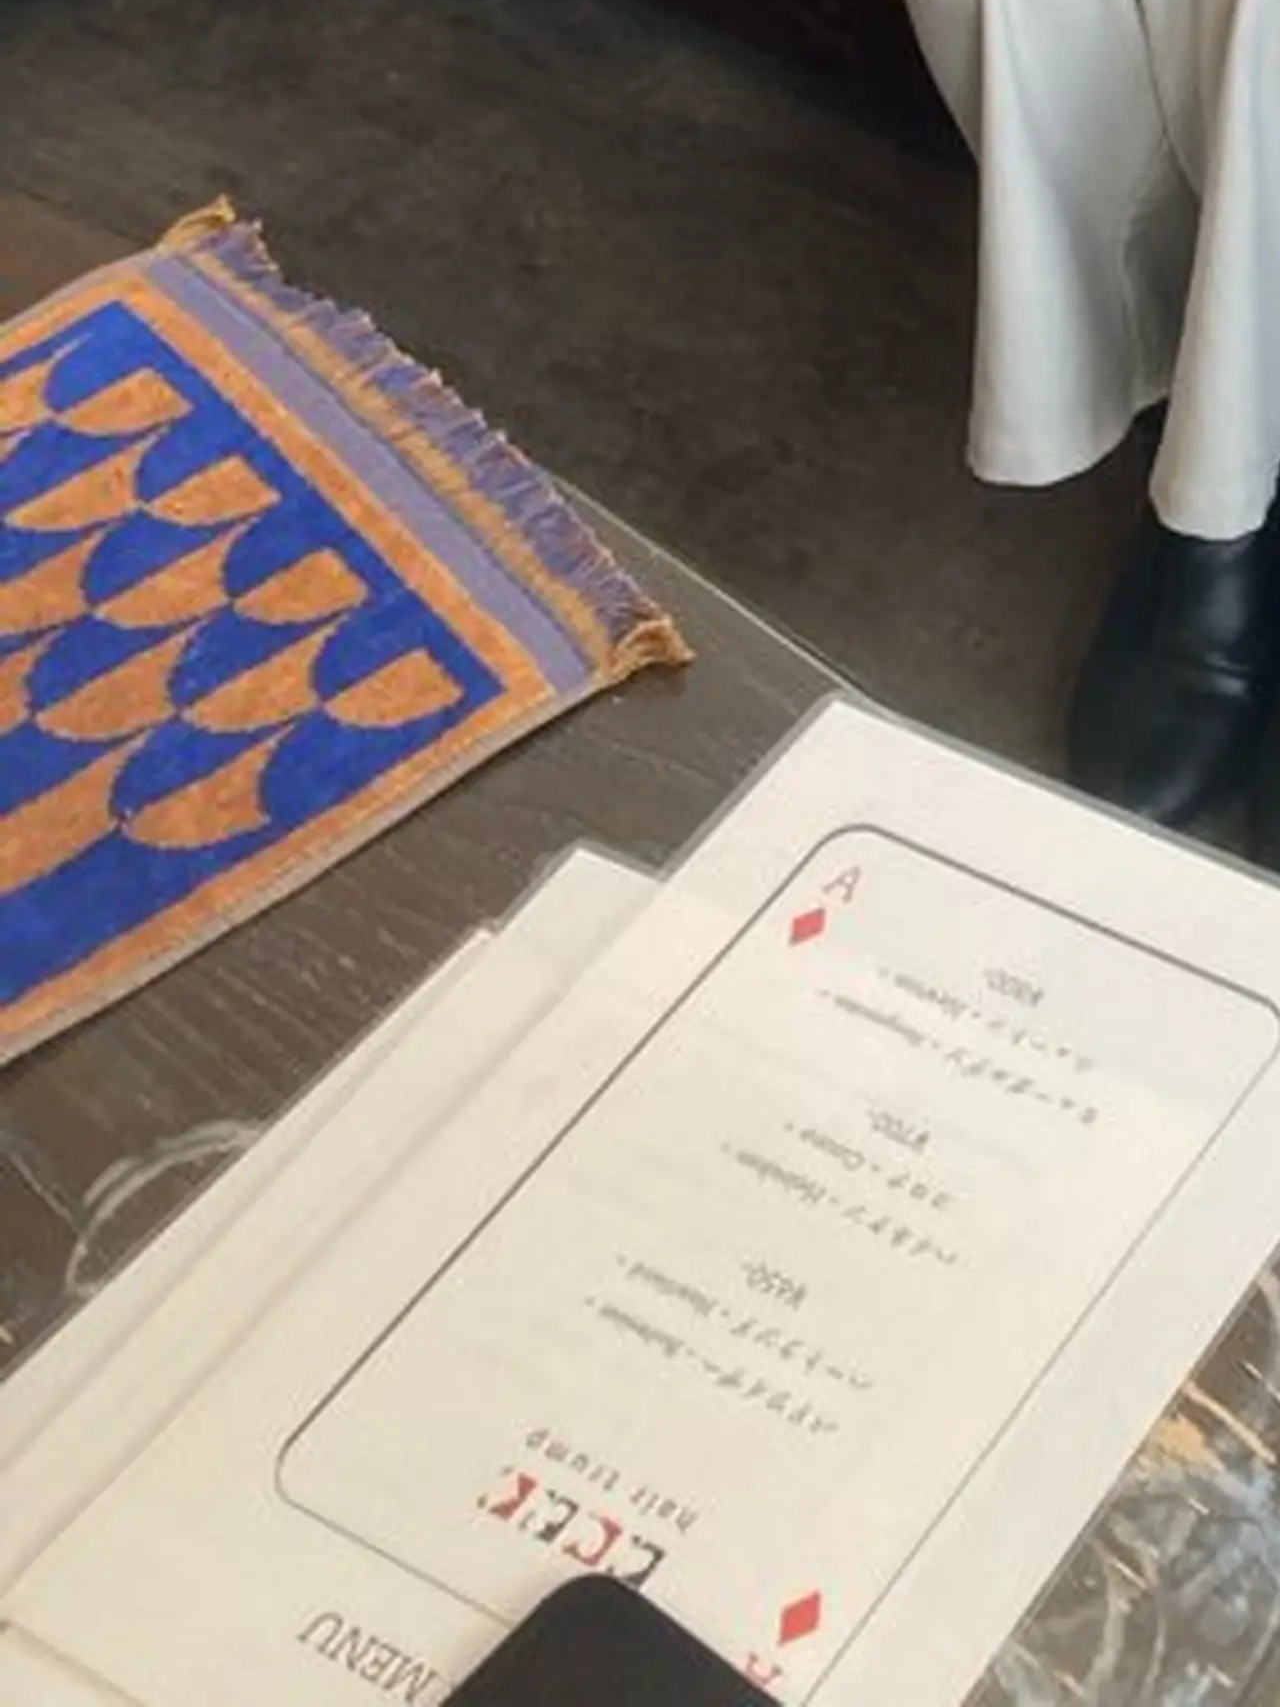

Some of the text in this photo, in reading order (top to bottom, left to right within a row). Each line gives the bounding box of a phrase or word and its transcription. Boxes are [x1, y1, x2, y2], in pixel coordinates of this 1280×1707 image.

[821, 865, 861, 903] A
[525, 1427, 620, 1491] trump
[296, 1611, 437, 1700] MENU
